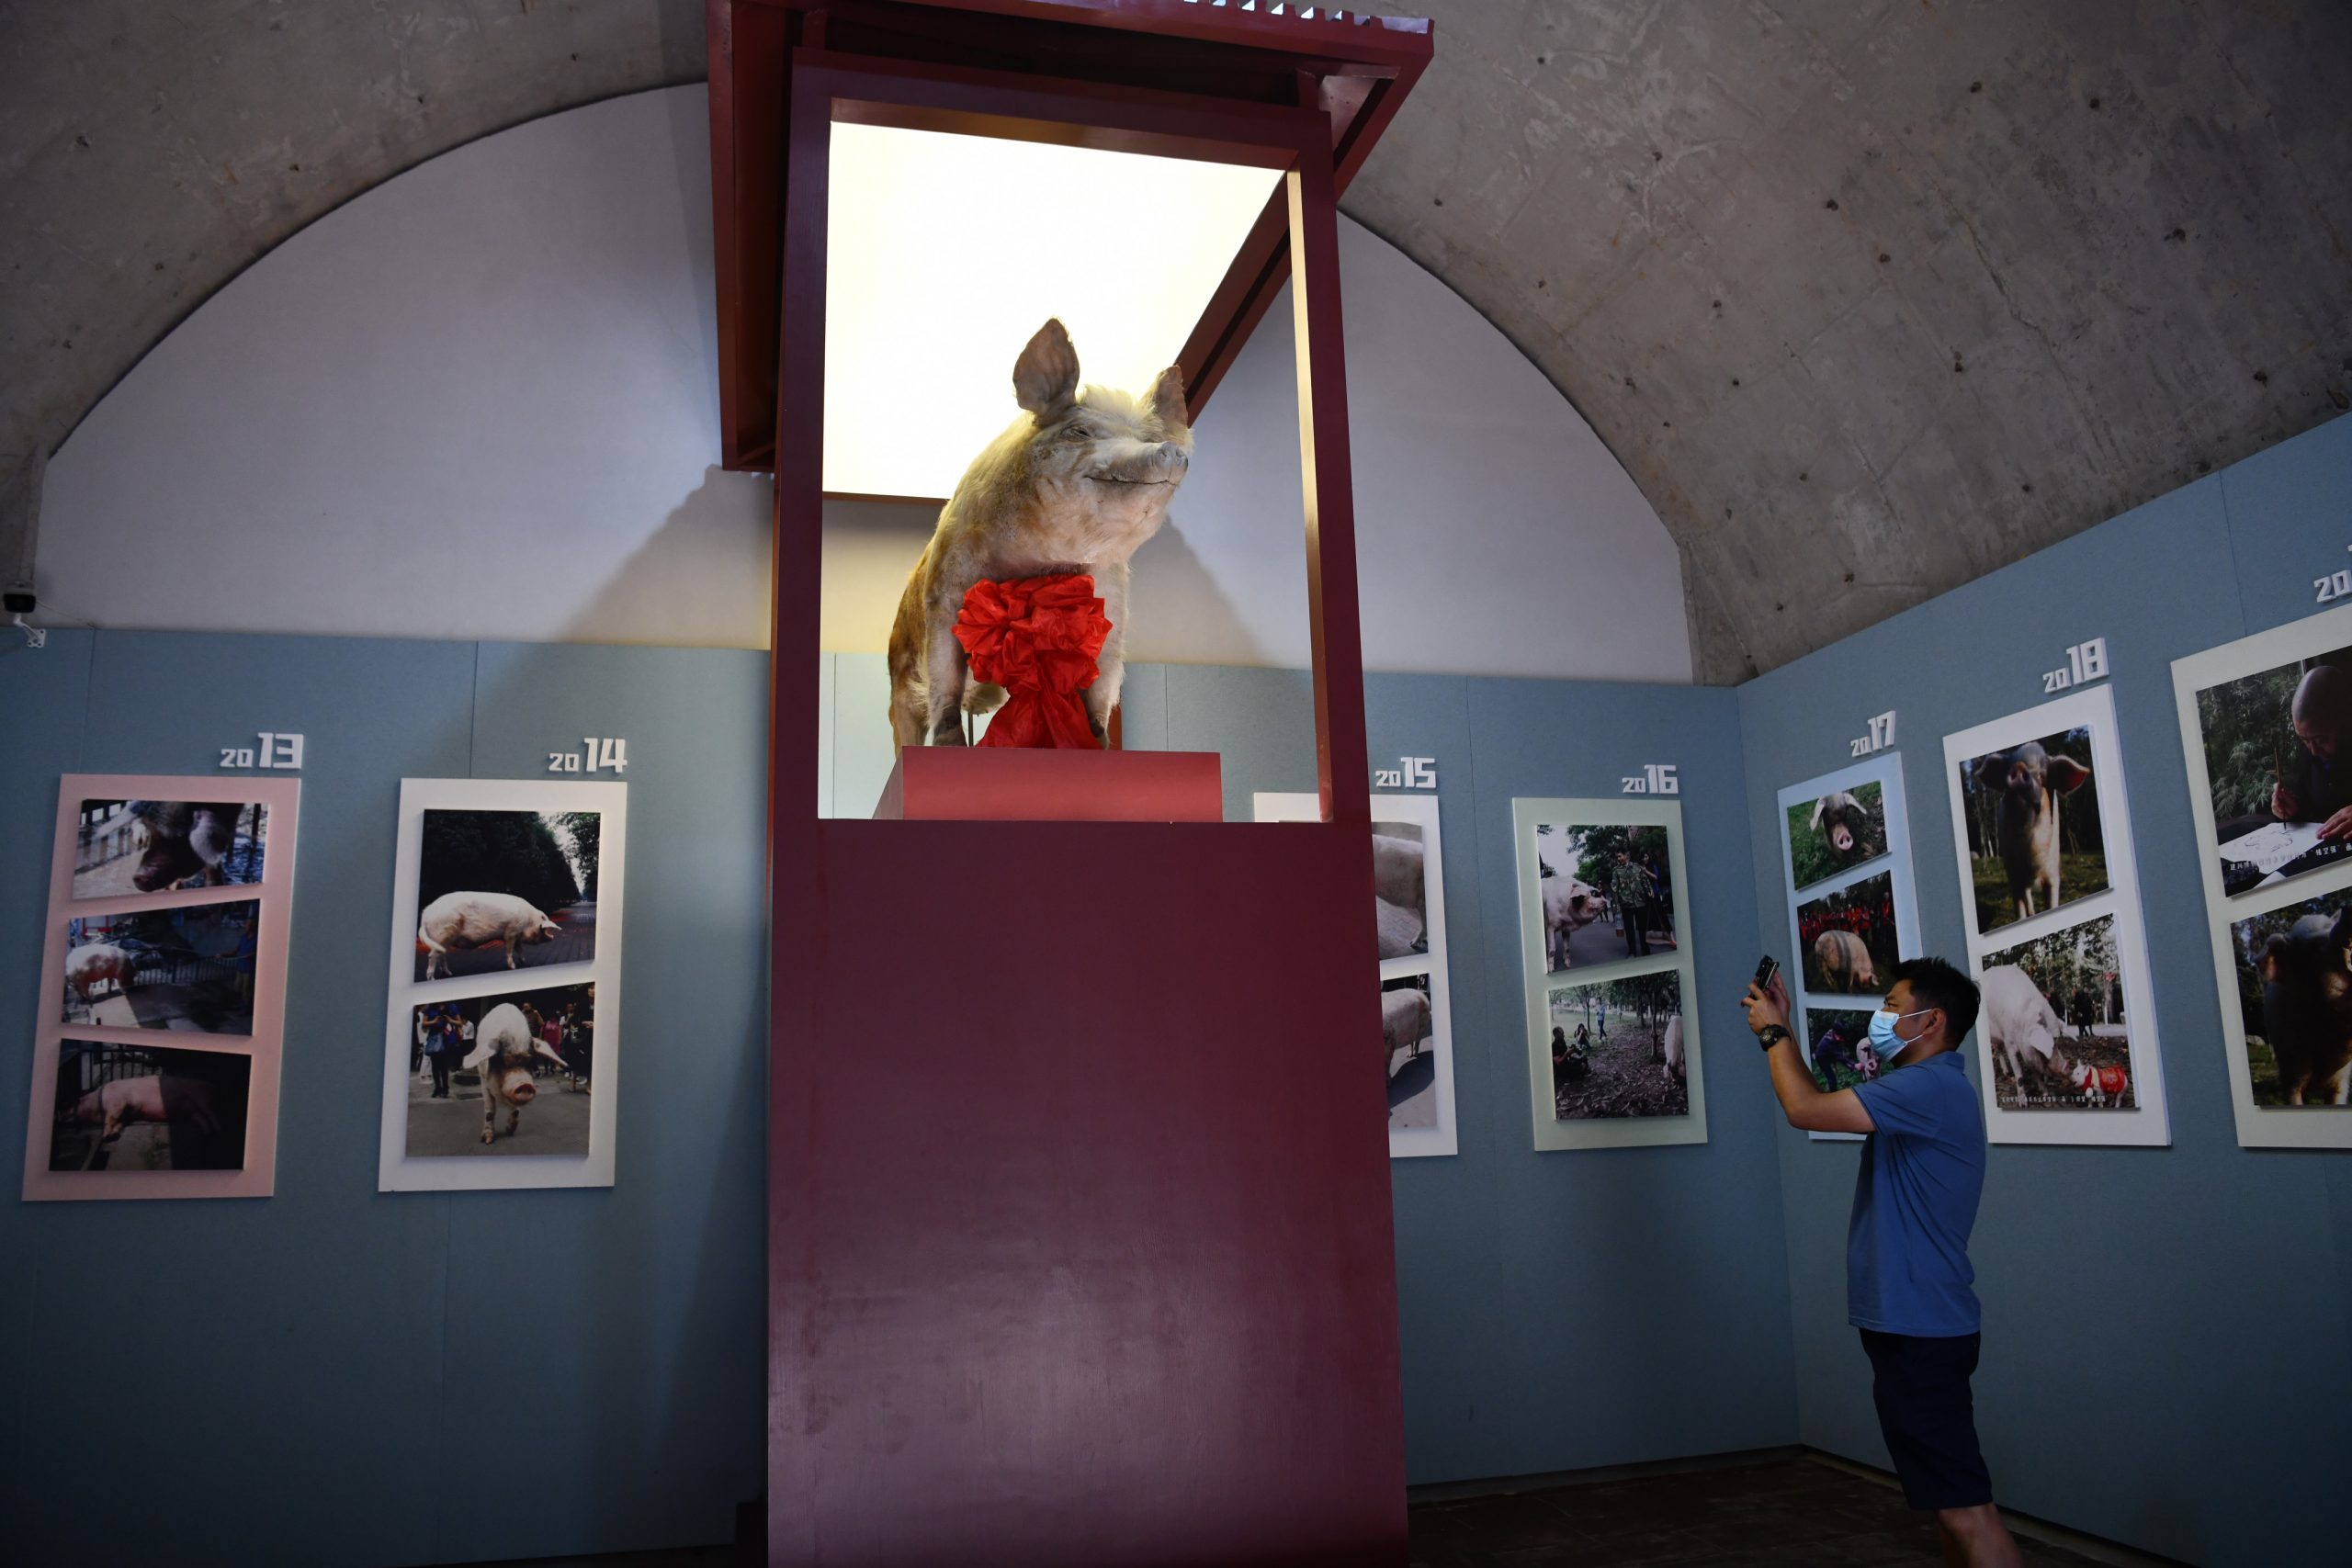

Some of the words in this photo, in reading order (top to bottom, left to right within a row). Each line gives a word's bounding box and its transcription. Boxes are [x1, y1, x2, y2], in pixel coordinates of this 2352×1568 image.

[2314, 544, 2352, 603] 20
[2042, 637, 2109, 694] 2018
[220, 732, 304, 770] 2013
[1850, 710, 1896, 758] 2017
[548, 738, 628, 773] 2014
[1375, 756, 1436, 788] 2015
[1622, 764, 1679, 795] 2016
